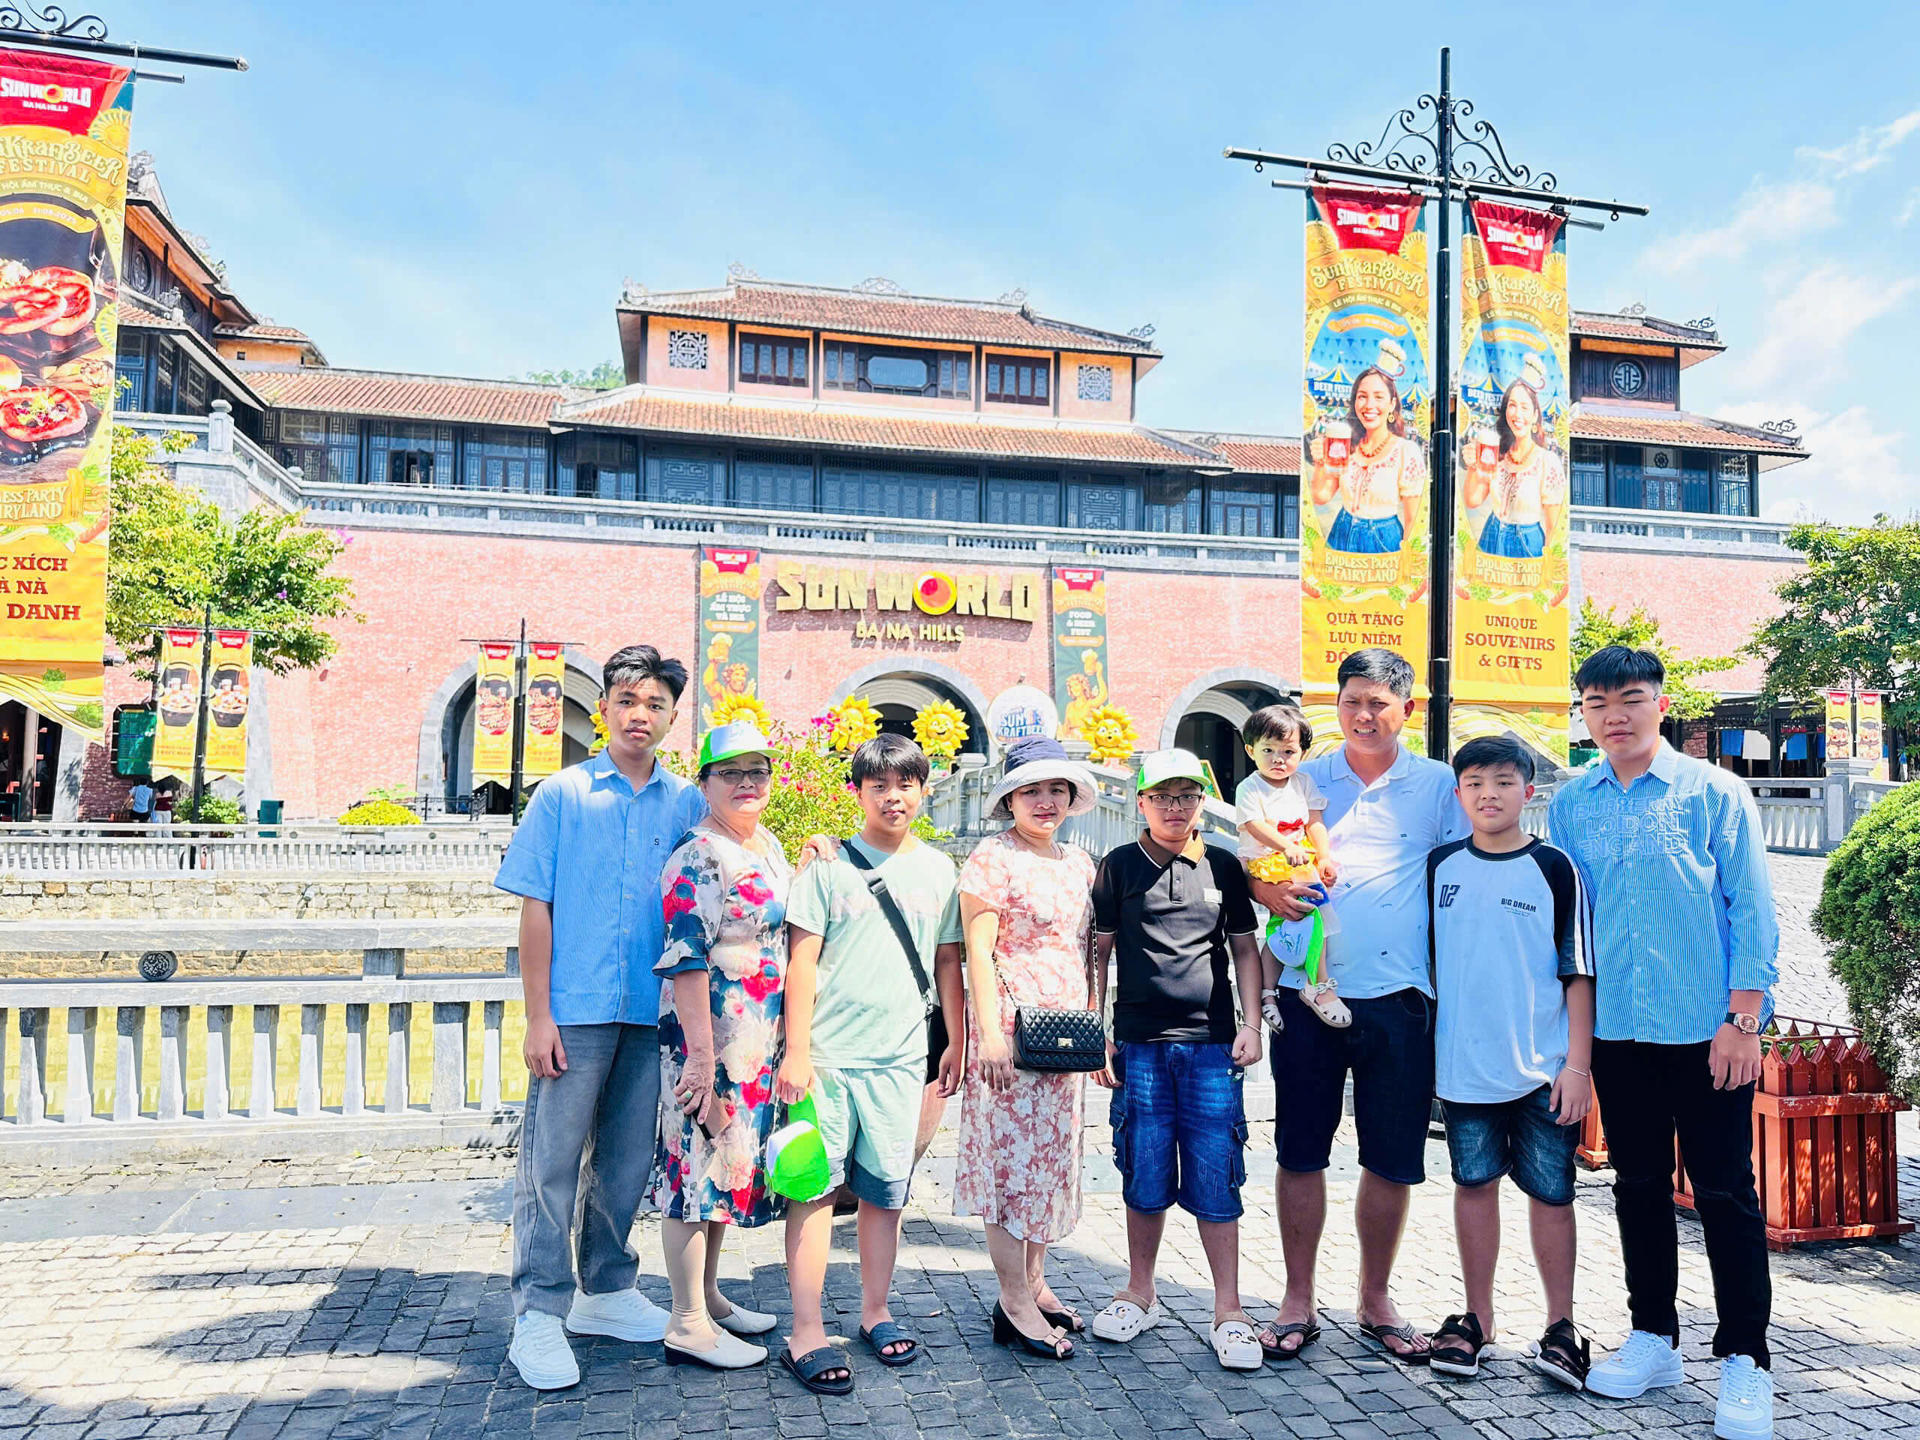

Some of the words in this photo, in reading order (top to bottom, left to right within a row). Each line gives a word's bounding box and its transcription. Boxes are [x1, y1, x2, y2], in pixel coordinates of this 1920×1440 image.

[27, 487, 68, 503] PARTY
[12, 553, 68, 571] XÍCH
[1325, 552, 1368, 569] ENDLESS
[1371, 555, 1400, 570] PARTY
[1334, 567, 1397, 584] FAIRYLAND
[16, 577, 48, 594] NÀ
[7, 603, 81, 620] DANH
[1485, 615, 1537, 630] UNIQUE
[920, 624, 965, 642] HILLS
[1465, 633, 1555, 651] SOUVENIRS
[1479, 654, 1491, 666] &
[1496, 655, 1542, 671] GIFTS
[1439, 884, 1461, 908] 02
[1501, 897, 1513, 906] BIG
[1513, 900, 1537, 913] DREAM
